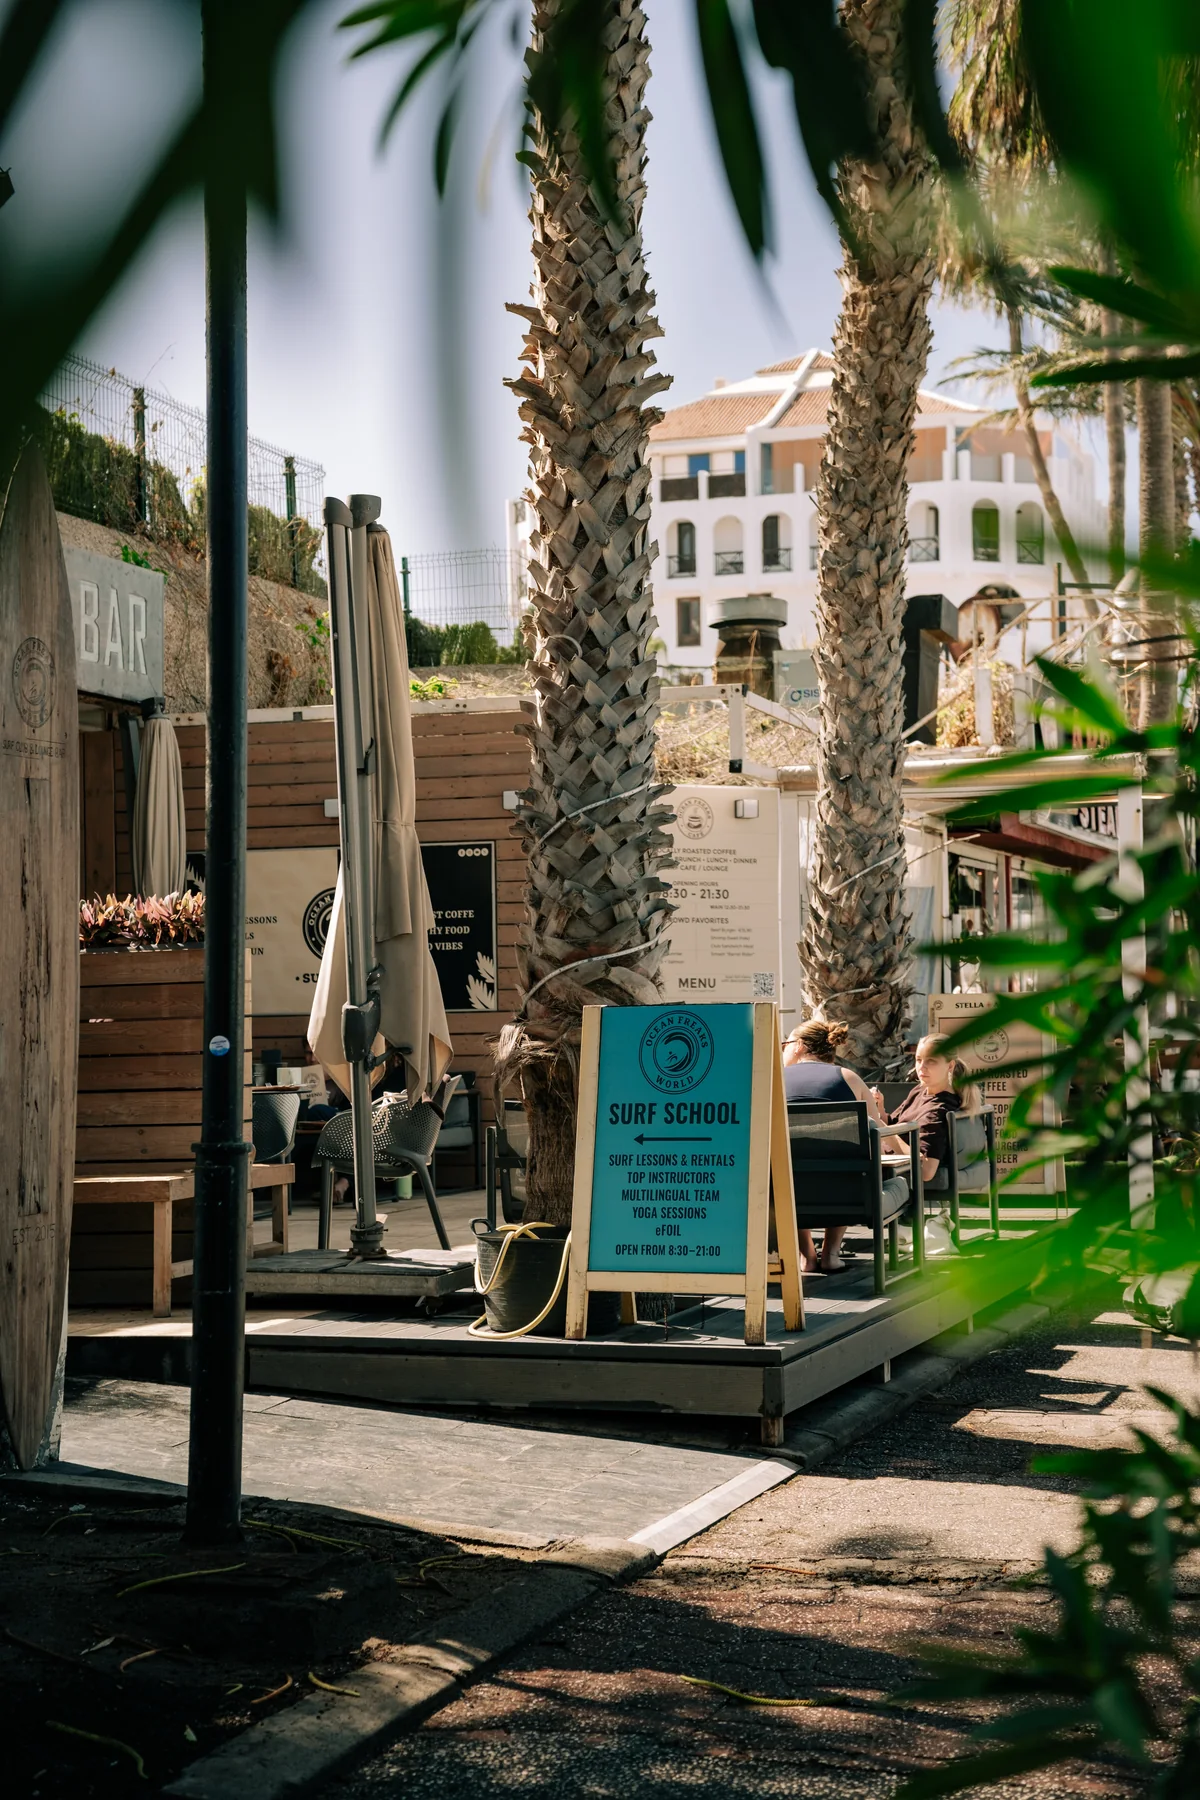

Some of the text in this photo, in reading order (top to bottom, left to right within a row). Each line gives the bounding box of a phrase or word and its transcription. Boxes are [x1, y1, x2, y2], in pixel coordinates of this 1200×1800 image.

[80, 579, 147, 675] BAR
[1077, 806, 1119, 838] STEA
[662, 889, 688, 898] 8:30
[700, 889, 729, 899] 21:30
[309, 895, 332, 926] OCEAN
[445, 910, 475, 918] COFFE
[245, 916, 278, 924] ESSONS
[445, 926, 470, 934] FOOD
[435, 942, 463, 950] VIBES
[679, 978, 716, 988] MENU
[646, 1016, 708, 1048] OCEAN FREAKS
[988, 1067, 1028, 1079] OASTED
[656, 1075, 694, 1089] WORLD
[987, 1082, 1007, 1091] FFEE
[609, 1102, 740, 1125] SURF SCHOOL
[609, 1154, 735, 1166] SURF LESSONS & RENTALS
[997, 1154, 1018, 1163] BEER
[628, 1172, 716, 1184] TOP INSTRUCTORS
[622, 1189, 720, 1201] MULTILINGUAL TEAM
[633, 1207, 707, 1219] YOGA SESSIONS
[655, 1224, 681, 1236] eFOIL
[615, 1244, 638, 1255] OPEN
[641, 1245, 666, 1255] FROM
